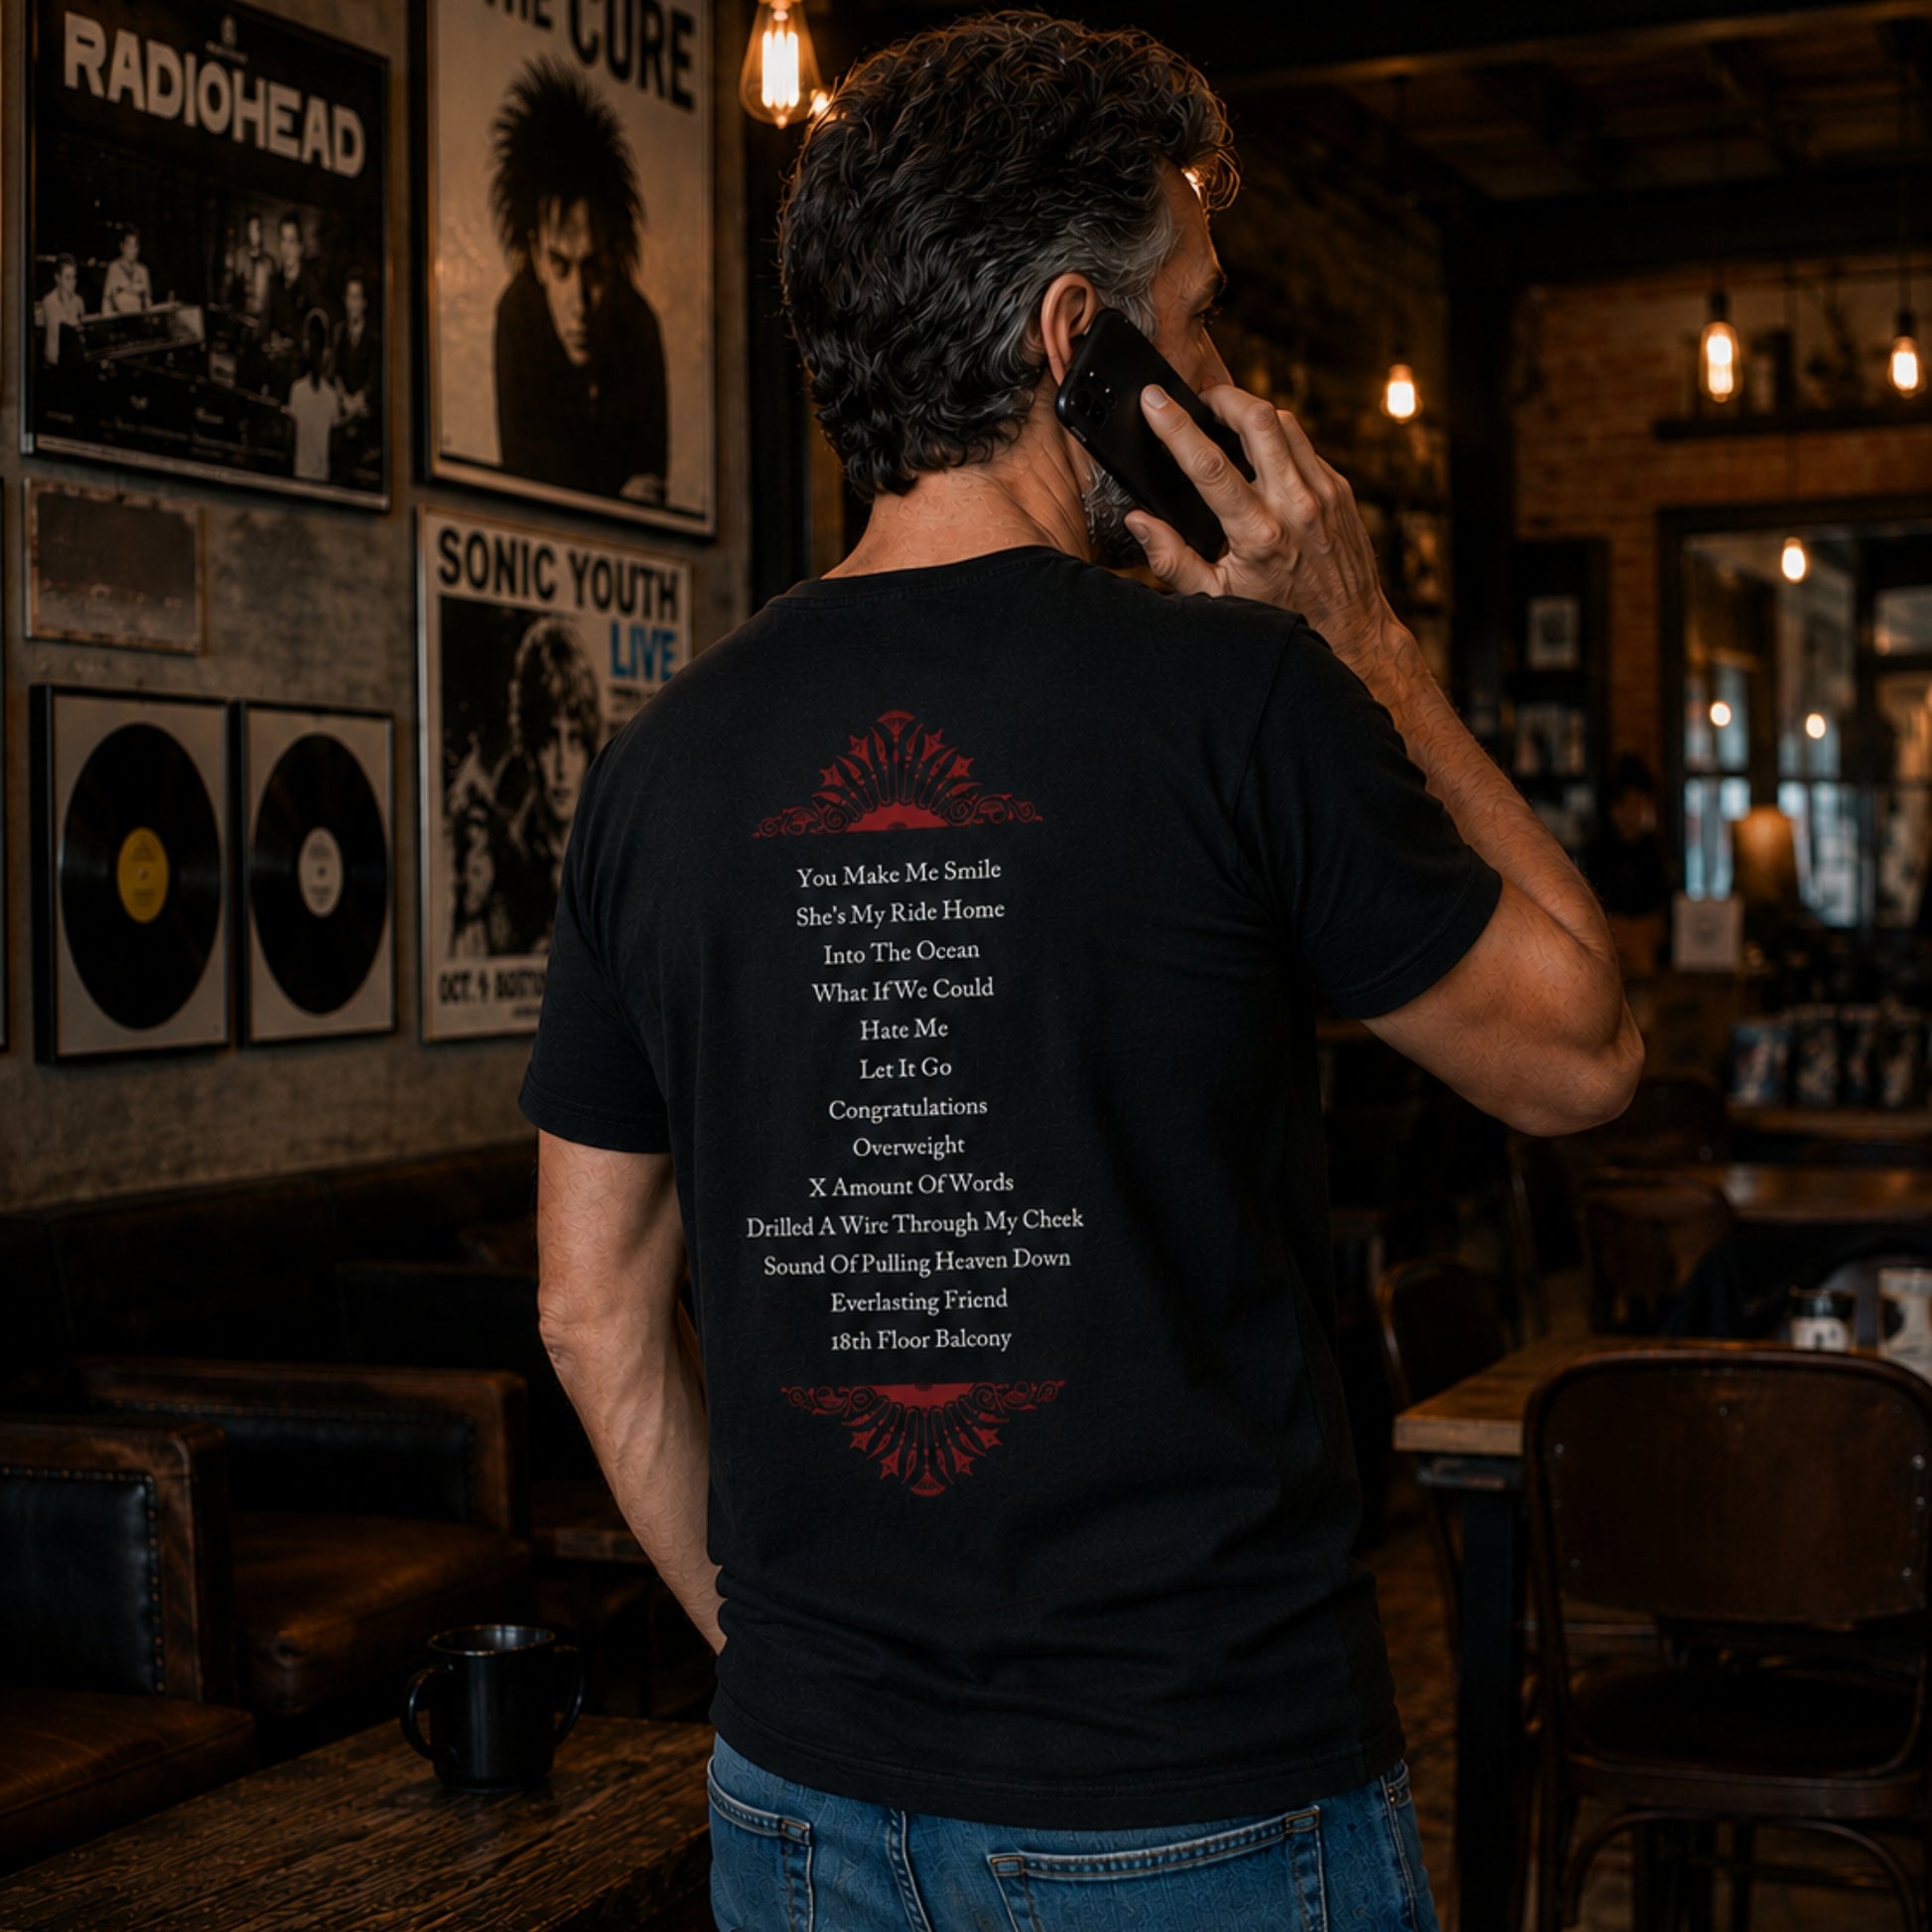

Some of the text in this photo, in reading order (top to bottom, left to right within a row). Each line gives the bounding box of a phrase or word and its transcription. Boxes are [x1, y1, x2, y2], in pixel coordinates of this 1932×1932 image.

[570, 0, 694, 113] CURE
[65, 11, 365, 178] RADIOHEAD
[439, 529, 678, 621] SONIC YOUTH
[611, 621, 676, 682] LIVE
[797, 859, 1001, 888] You Make Me Smile
[797, 899, 1005, 929] She's My Ride Home
[824, 940, 980, 965] Into The Ocean
[812, 976, 994, 1002] What If We Could
[861, 1018, 948, 1040] Hate Me
[860, 1057, 952, 1078] Let It Go
[829, 1097, 987, 1124] Congratulations
[853, 1135, 965, 1161] Overweight
[809, 1172, 1014, 1197] X Amount Of Words
[747, 1208, 1083, 1237] Drilled A Wire Through My Cheek
[764, 1248, 1070, 1278] Sound Of Pulling Heaven Down
[831, 1288, 1008, 1316] Everlasting Friend
[832, 1328, 1012, 1352] 18th Floor Balcony
